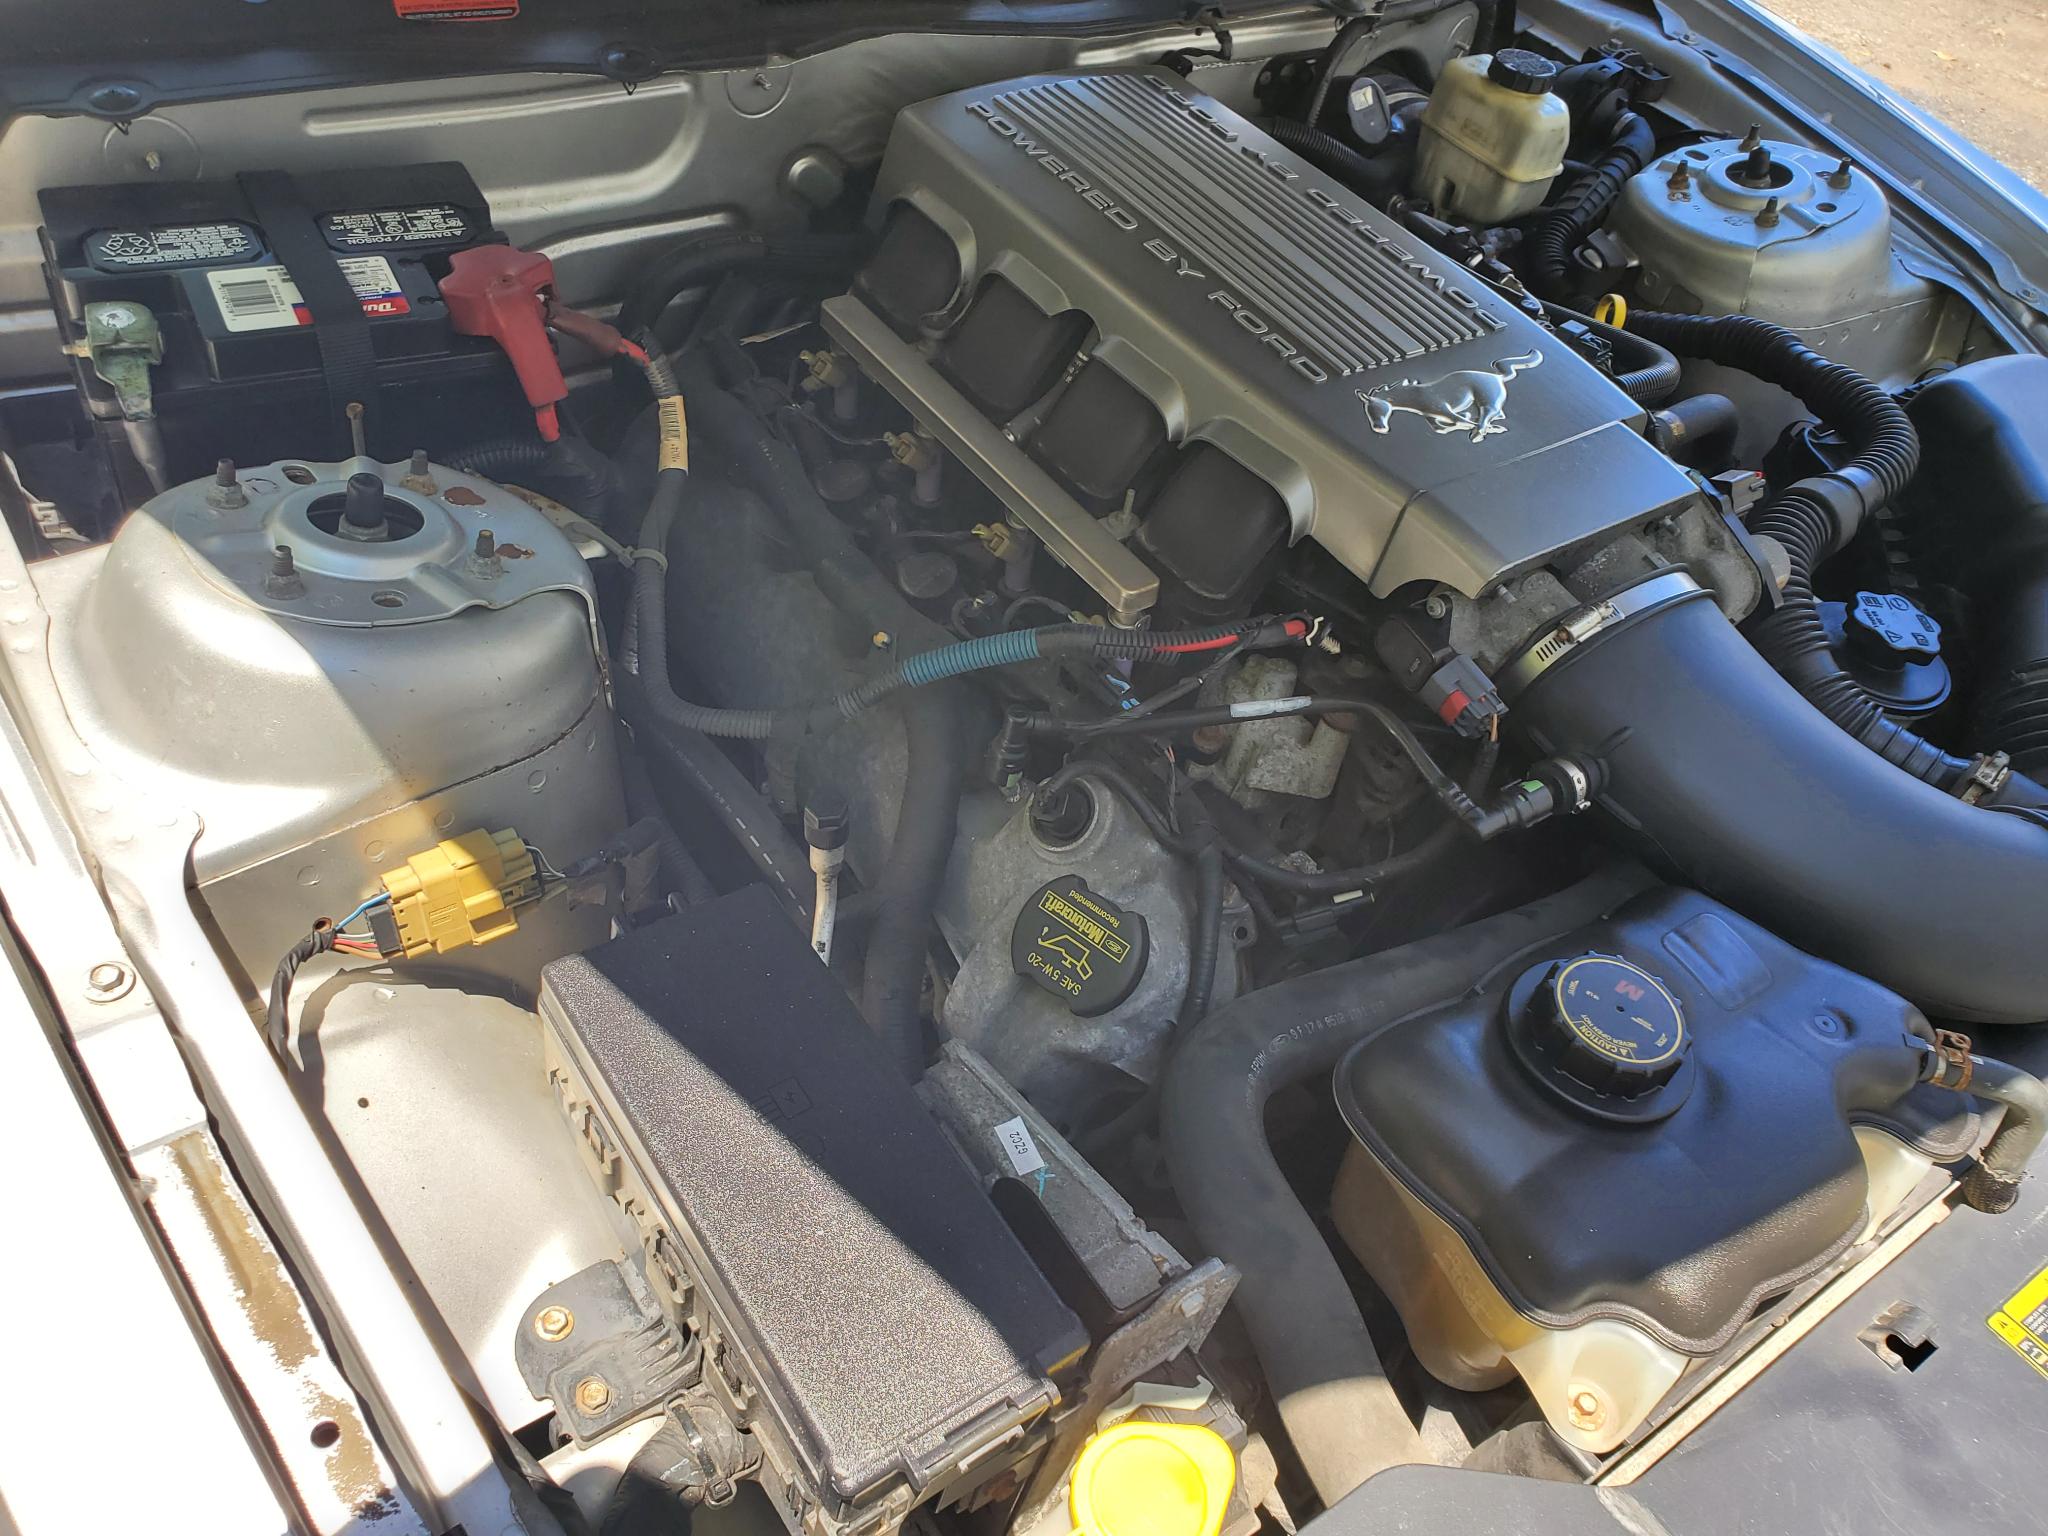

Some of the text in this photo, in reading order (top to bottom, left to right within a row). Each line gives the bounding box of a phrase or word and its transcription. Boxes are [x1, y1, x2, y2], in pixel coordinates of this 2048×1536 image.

[1143, 75, 1507, 331] POWERED BY FORD
[346, 236, 392, 245] POISON
[404, 230, 454, 240] DANGER
[964, 102, 1331, 383] POWERED BY FORD
[1044, 894, 1105, 944] Motorcraft
[1069, 890, 1120, 928] Recommended
[1026, 953, 1082, 996] SAE 5W-20
[1580, 1014, 1593, 1030] HOT
[1592, 1025, 1612, 1041] OPEN
[1579, 1024, 1618, 1054] CAUTION
[1612, 1037, 1638, 1049] NEVER
